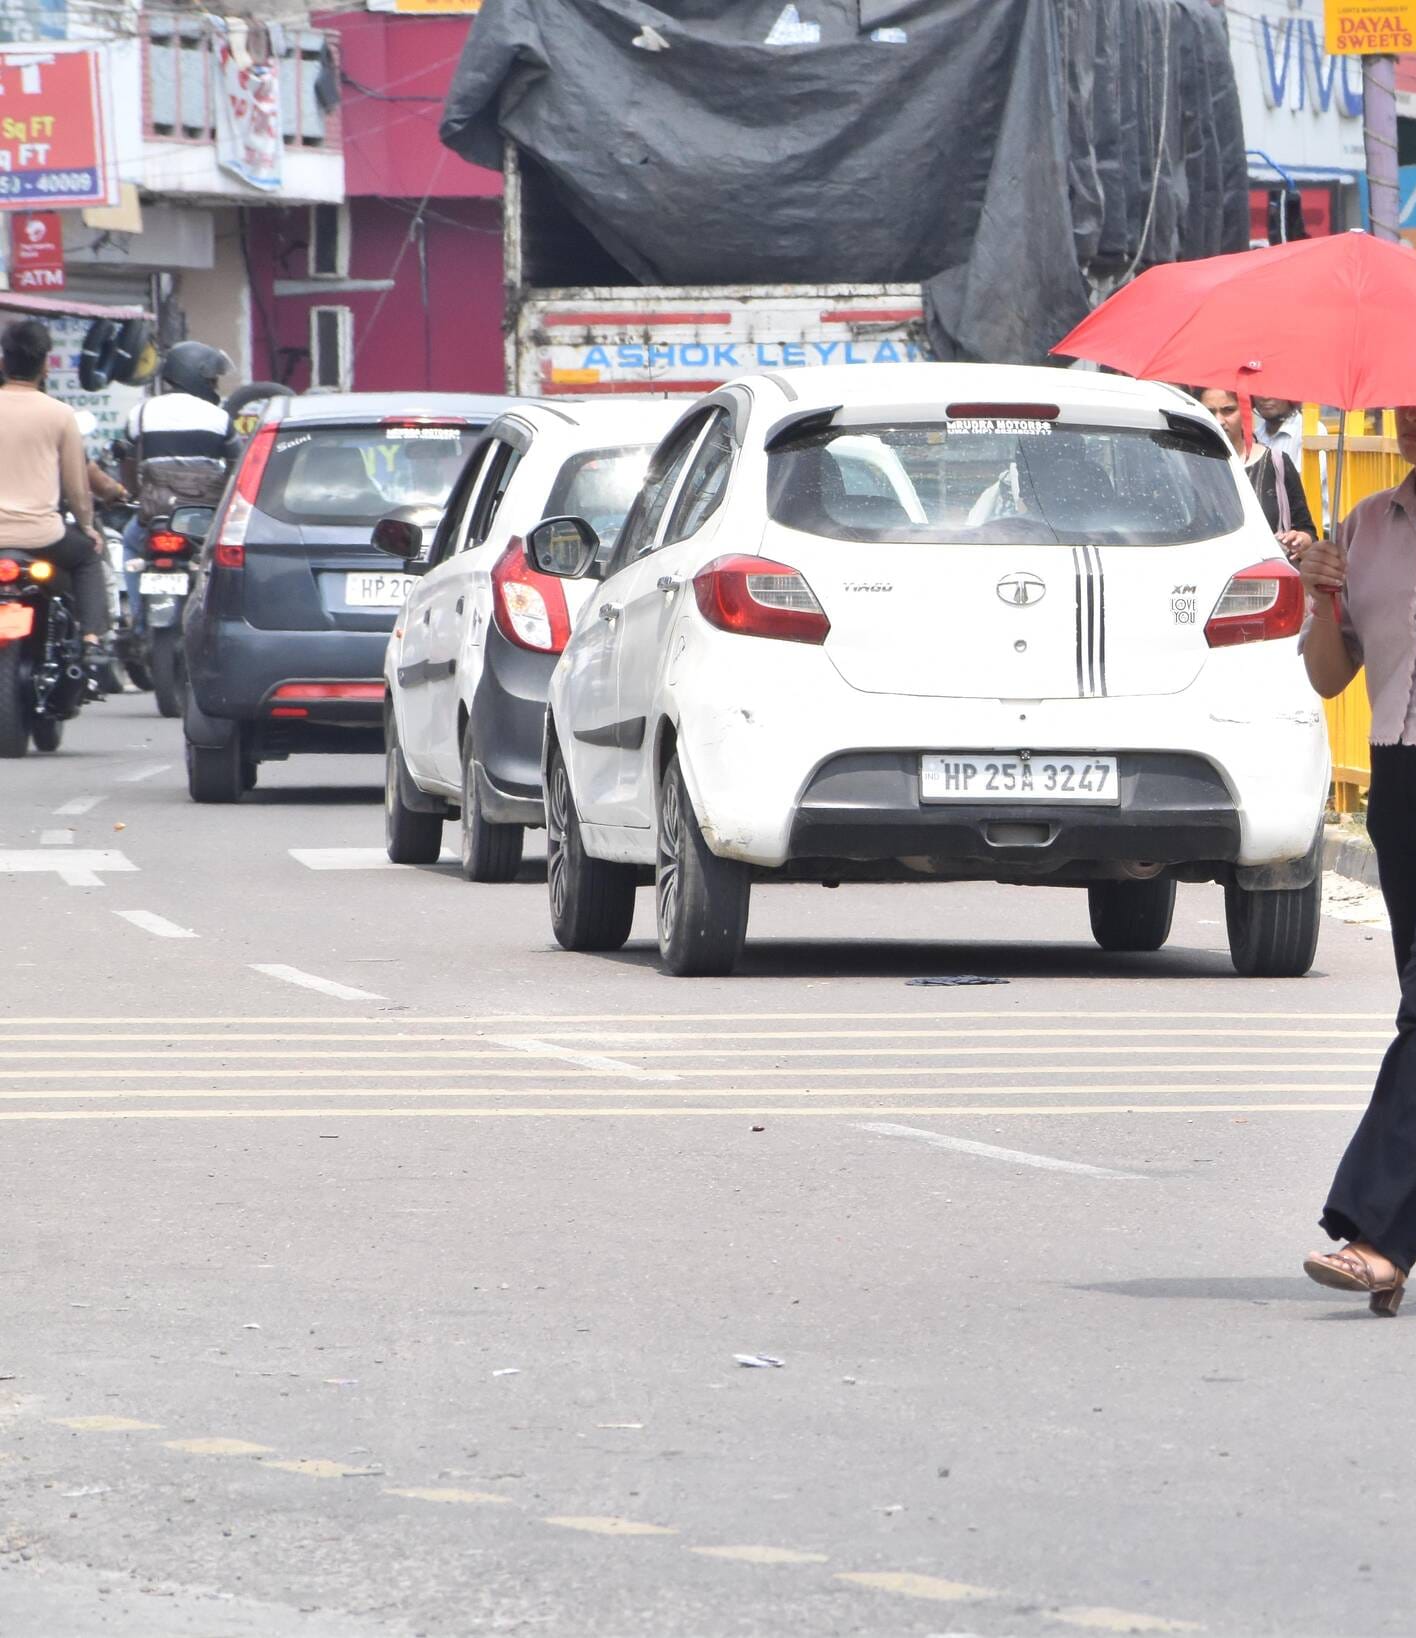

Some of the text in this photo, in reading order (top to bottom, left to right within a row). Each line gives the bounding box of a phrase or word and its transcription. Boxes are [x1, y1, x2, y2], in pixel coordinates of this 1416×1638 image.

[1339, 16, 1408, 33] DAYAL
[1337, 33, 1413, 49] SWEETS
[31, 115, 56, 139] FT
[582, 342, 740, 369] ASHOK
[362, 579, 385, 598] HP
[1171, 585, 1197, 594] XM
[1171, 598, 1197, 611] LOVE
[1174, 611, 1196, 624] YOU
[944, 763, 977, 790] HP
[1043, 764, 1110, 792] 3247
